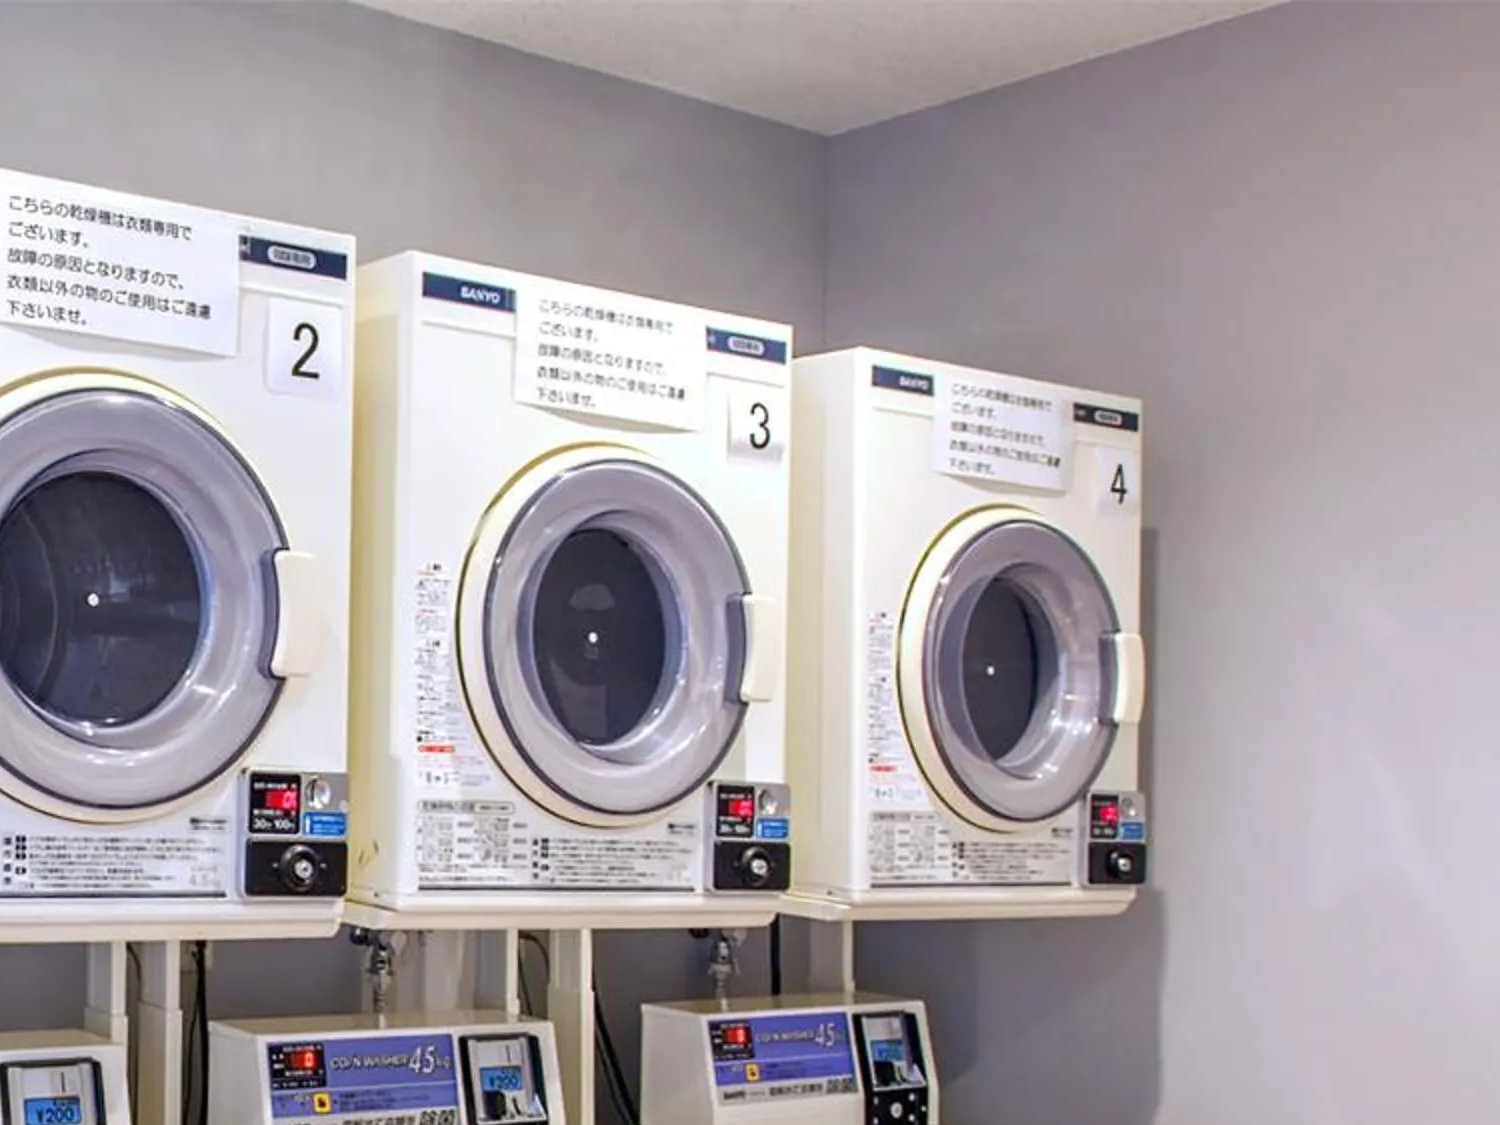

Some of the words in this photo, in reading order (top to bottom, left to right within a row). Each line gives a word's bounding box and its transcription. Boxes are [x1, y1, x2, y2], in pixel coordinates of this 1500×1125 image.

[7, 221, 90, 249] ございます。
[8, 195, 193, 241] こちらの乾燥機は衣類専用で
[7, 247, 185, 290] 故障の原因となりますので、
[7, 299, 88, 326] 下さいませ。
[291, 322, 320, 380] 2
[748, 402, 771, 450] 3
[1109, 463, 1128, 505] 4
